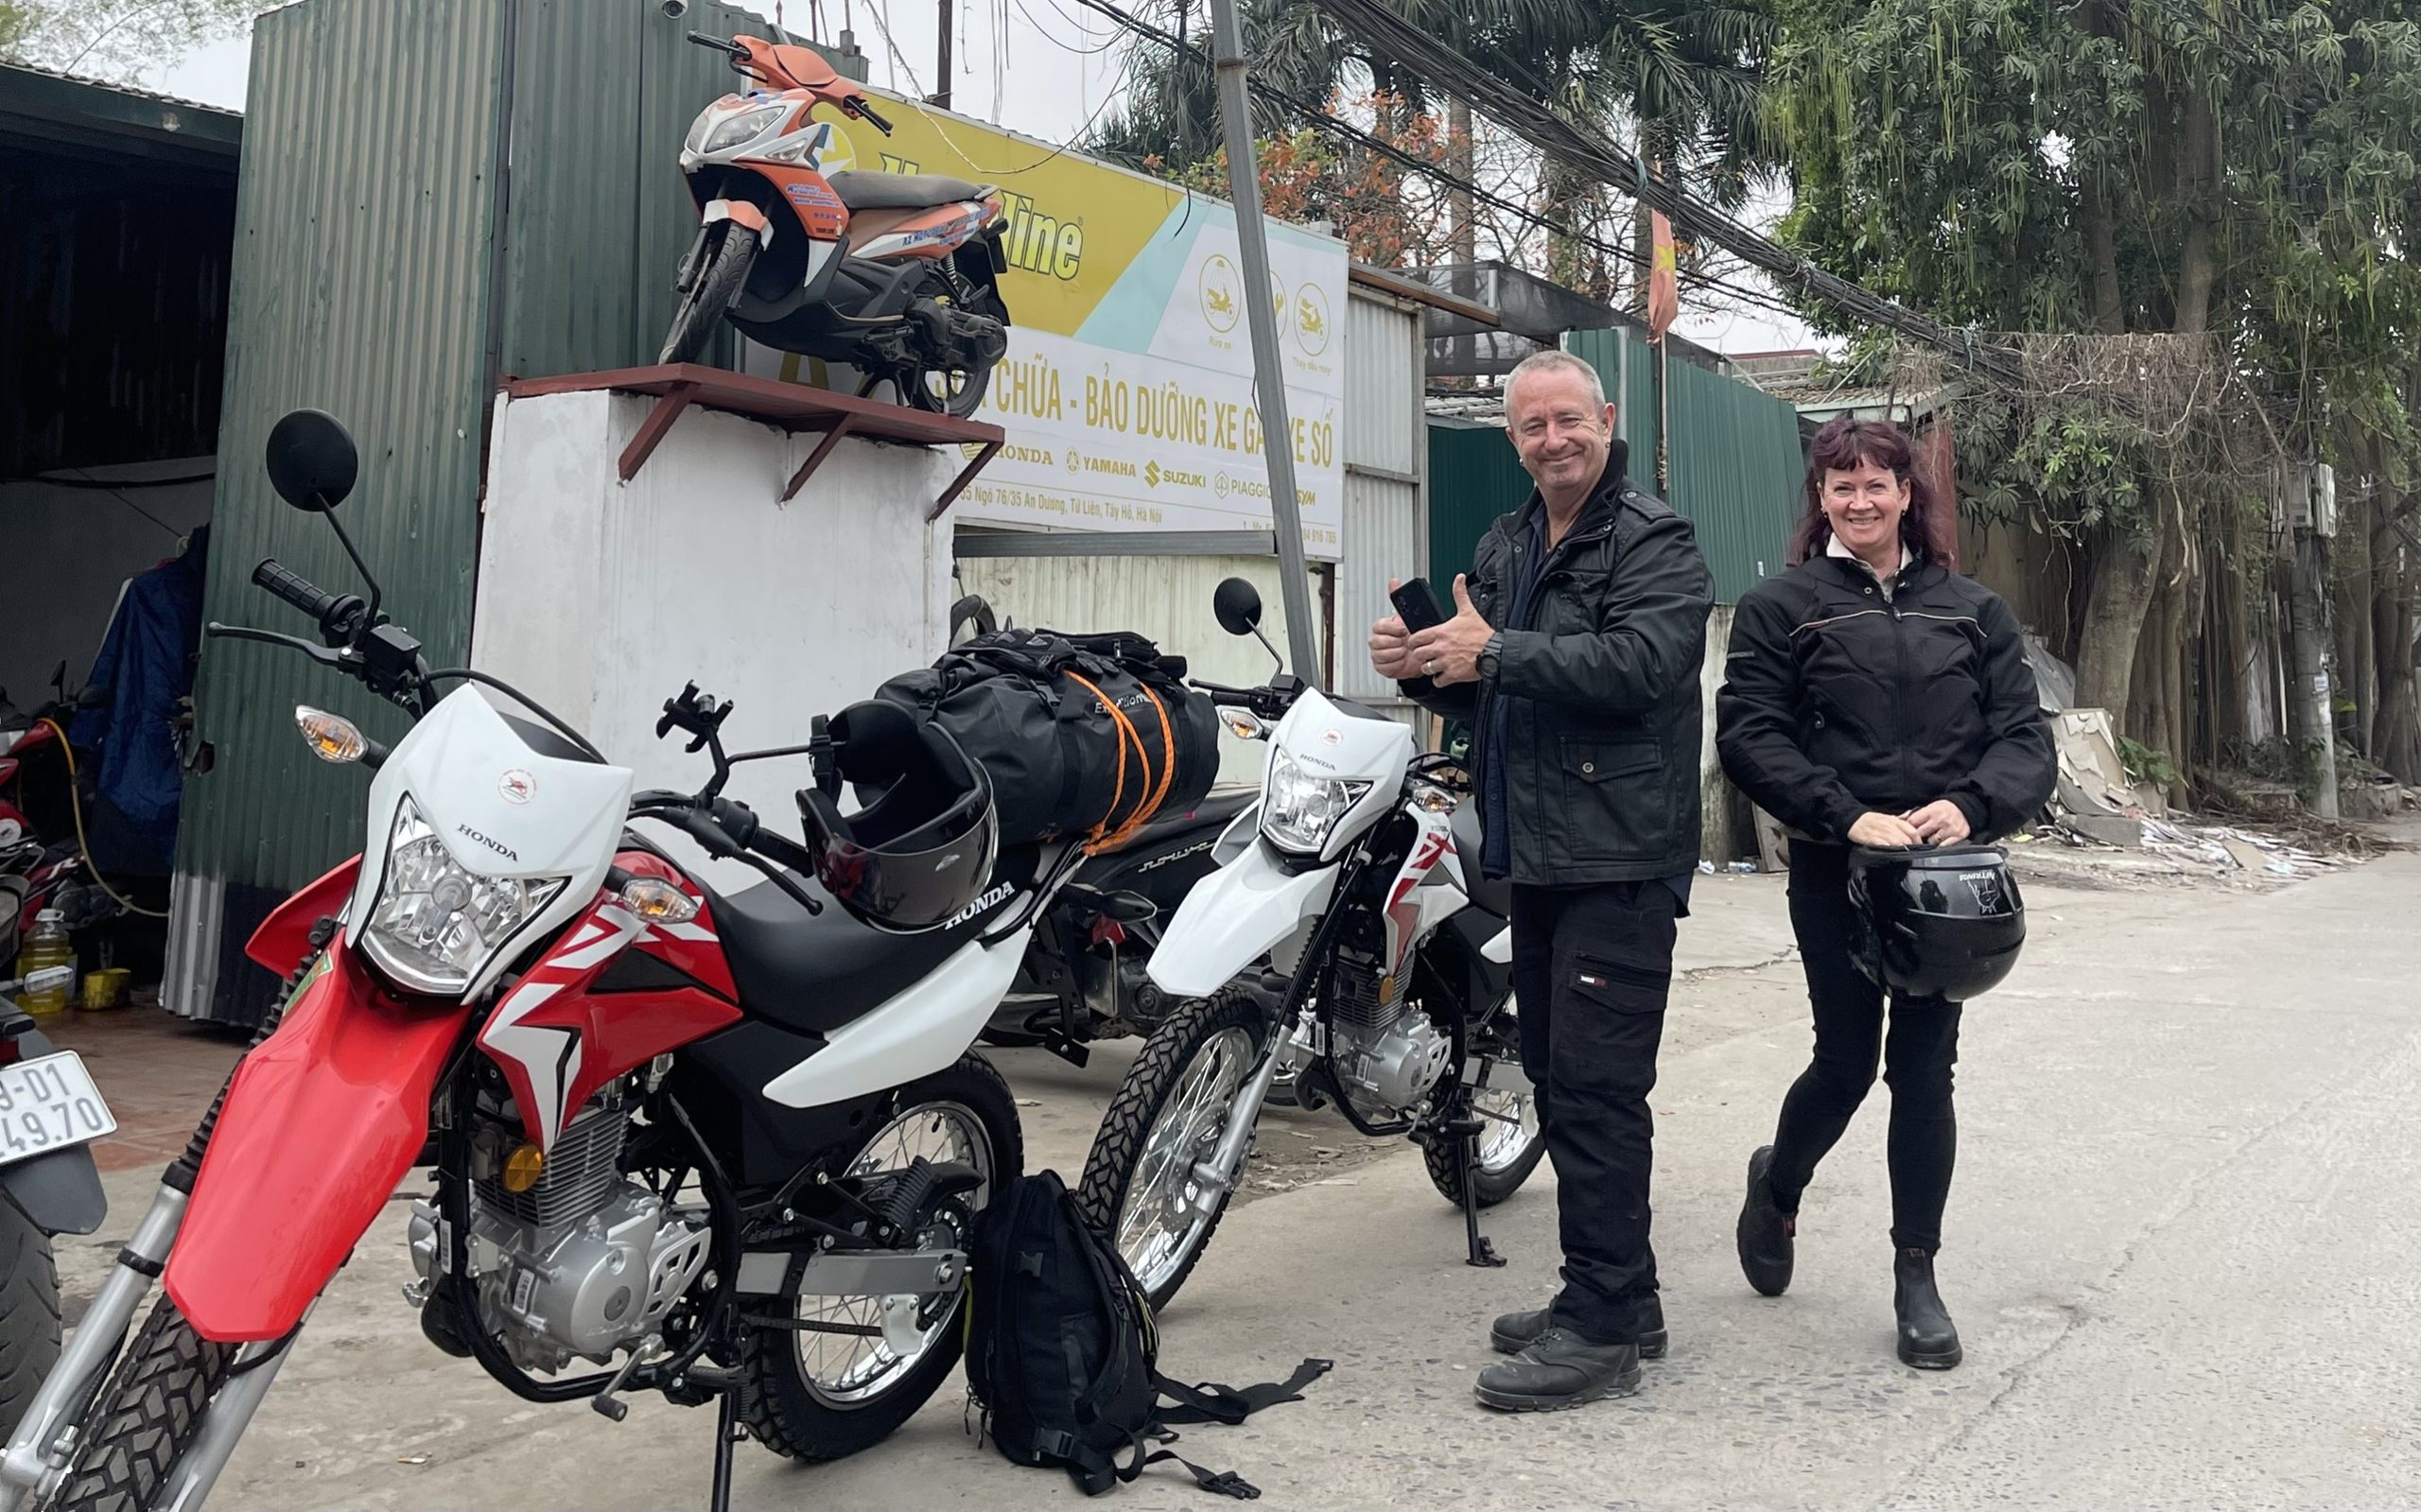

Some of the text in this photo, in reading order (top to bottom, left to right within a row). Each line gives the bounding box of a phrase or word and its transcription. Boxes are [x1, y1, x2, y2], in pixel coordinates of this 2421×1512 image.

[996, 353, 1062, 421] CHỮA
[1086, 362, 1128, 433] BẢO
[1137, 381, 1207, 446] DƯỠNG
[1213, 401, 1237, 450] XE
[1311, 408, 1333, 468] SỐ
[1084, 457, 1137, 478] YAMAHA
[1163, 470, 1206, 488] SUZUKI
[996, 488, 1021, 508] 76/35
[1024, 494, 1036, 508] An
[1299, 753, 1336, 771] HONDA
[457, 823, 518, 862] HONDA
[0, 1097, 103, 1158] 49.70
